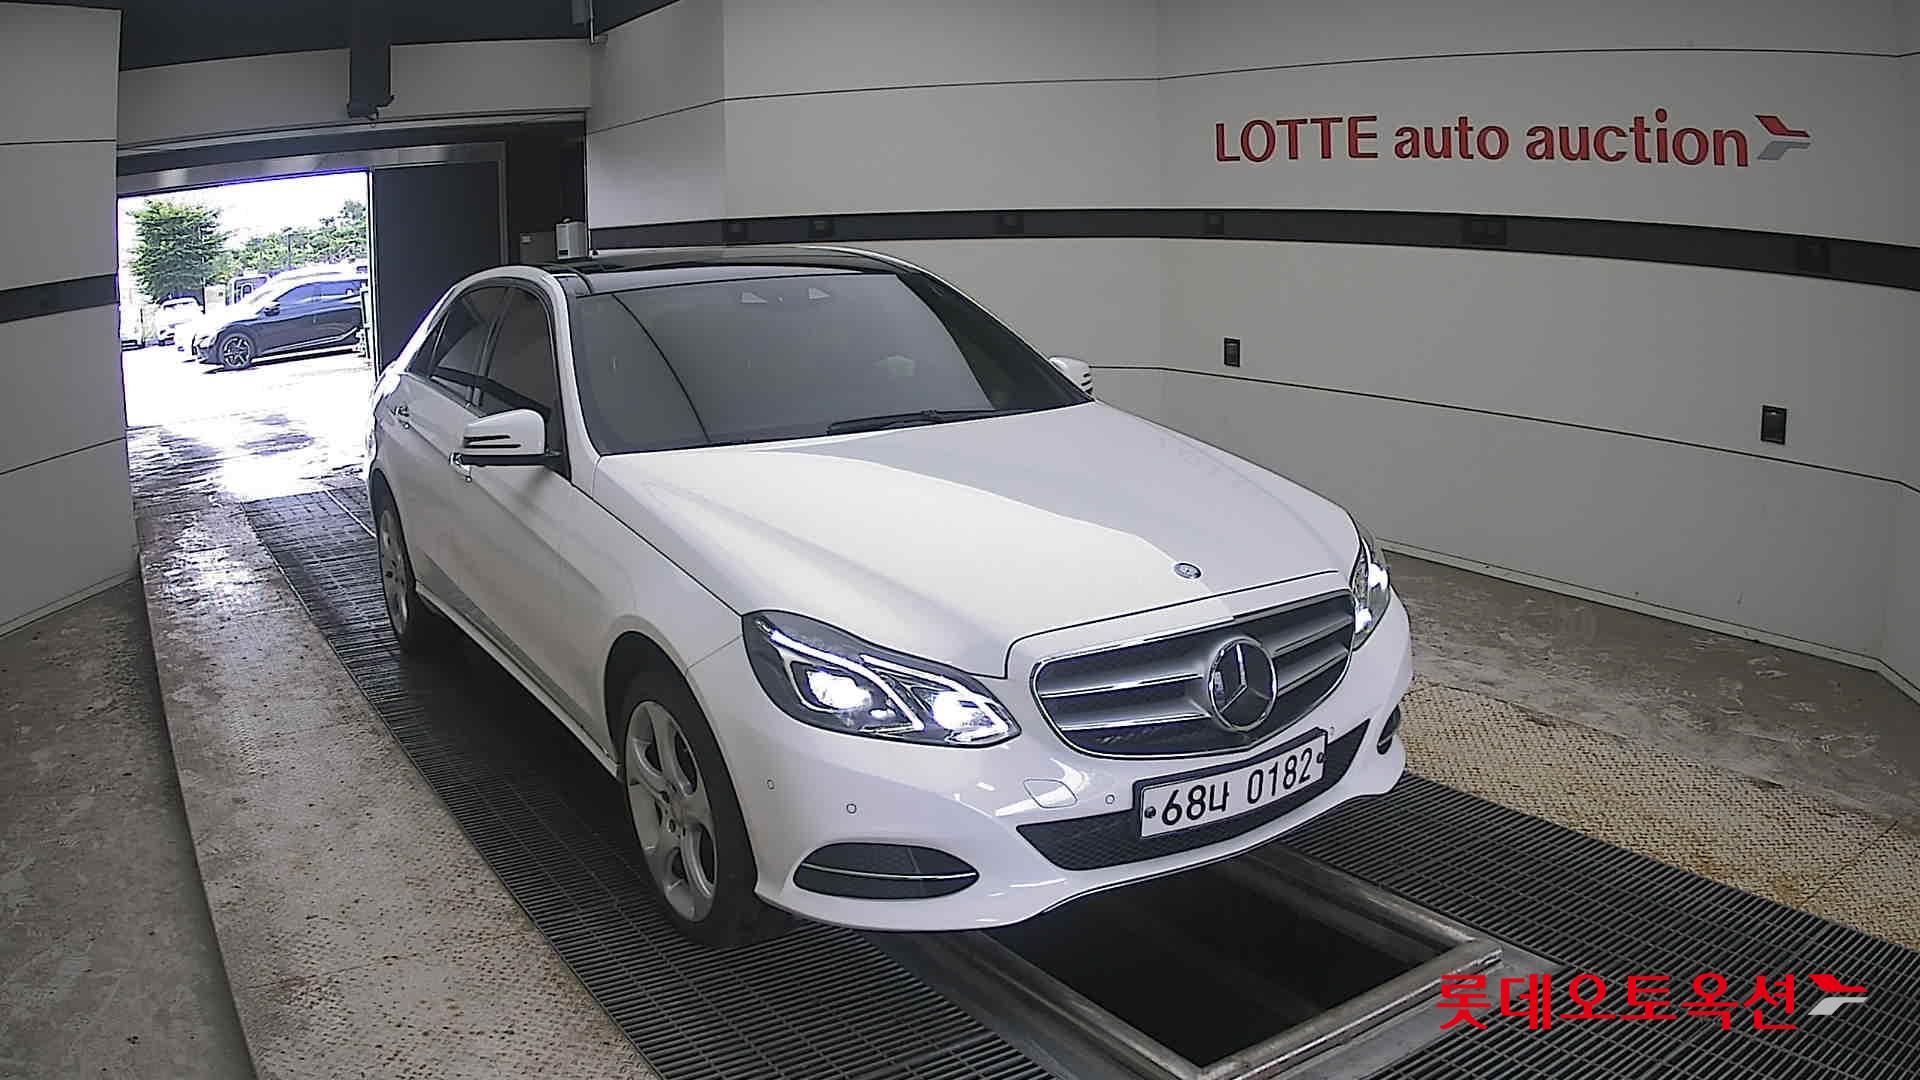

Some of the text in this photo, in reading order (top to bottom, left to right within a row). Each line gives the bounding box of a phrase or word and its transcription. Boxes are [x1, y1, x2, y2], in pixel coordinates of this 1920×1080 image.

[1215, 108, 1749, 167] LOTTE auto auction
[1161, 747, 1313, 826] 68나 0182
